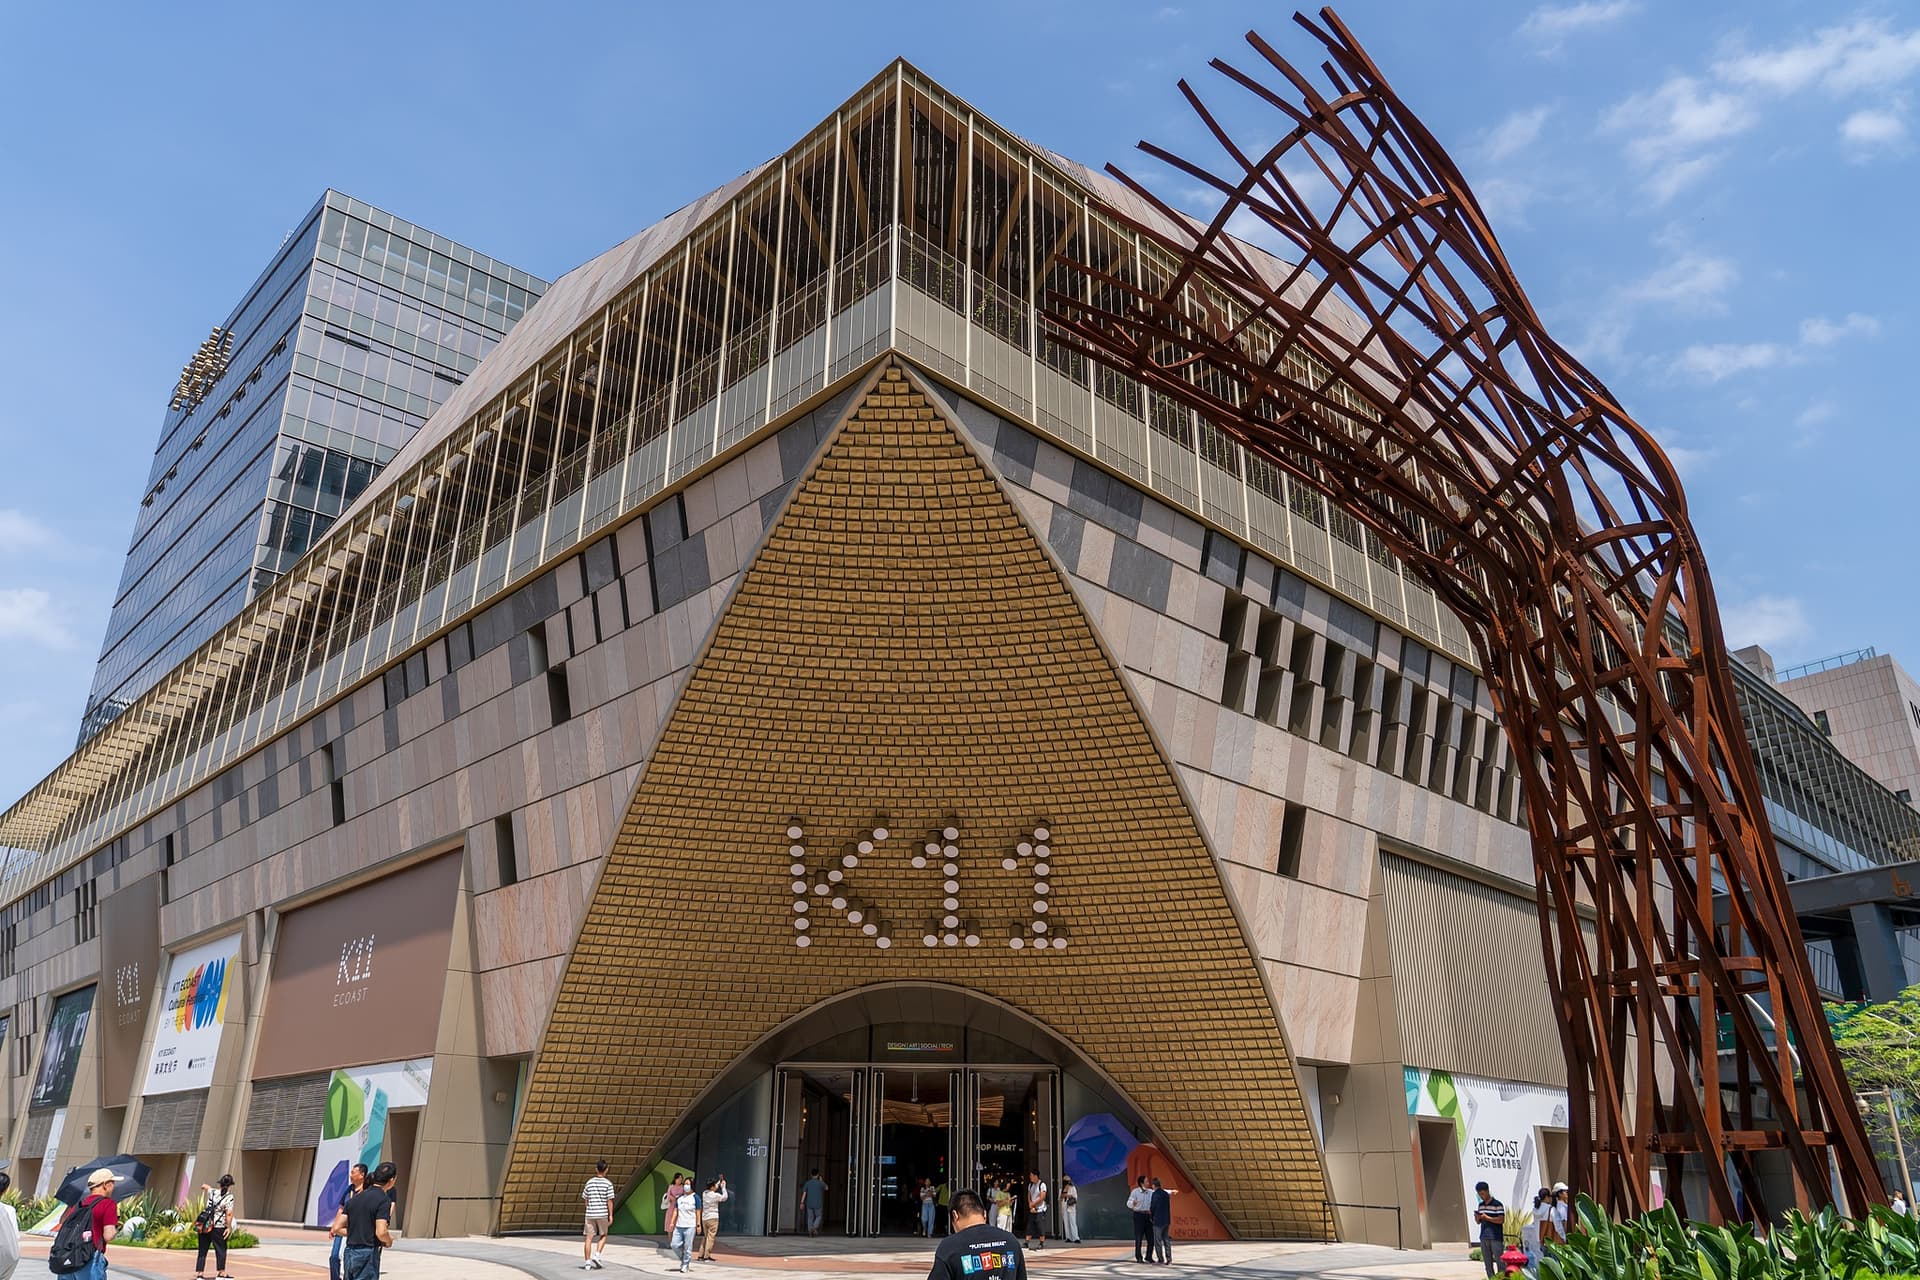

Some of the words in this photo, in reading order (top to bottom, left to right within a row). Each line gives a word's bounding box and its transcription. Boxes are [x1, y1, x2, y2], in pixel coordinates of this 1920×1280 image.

[787, 818, 1068, 950] K11
[336, 934, 375, 985] K11
[117, 962, 141, 1007] K11
[180, 975, 201, 992] ECOAST
[333, 987, 369, 1007] ECOAST
[746, 1145, 768, 1157] 北门
[1473, 1138, 1486, 1156] K11
[1485, 1138, 1519, 1158] ECOAST
